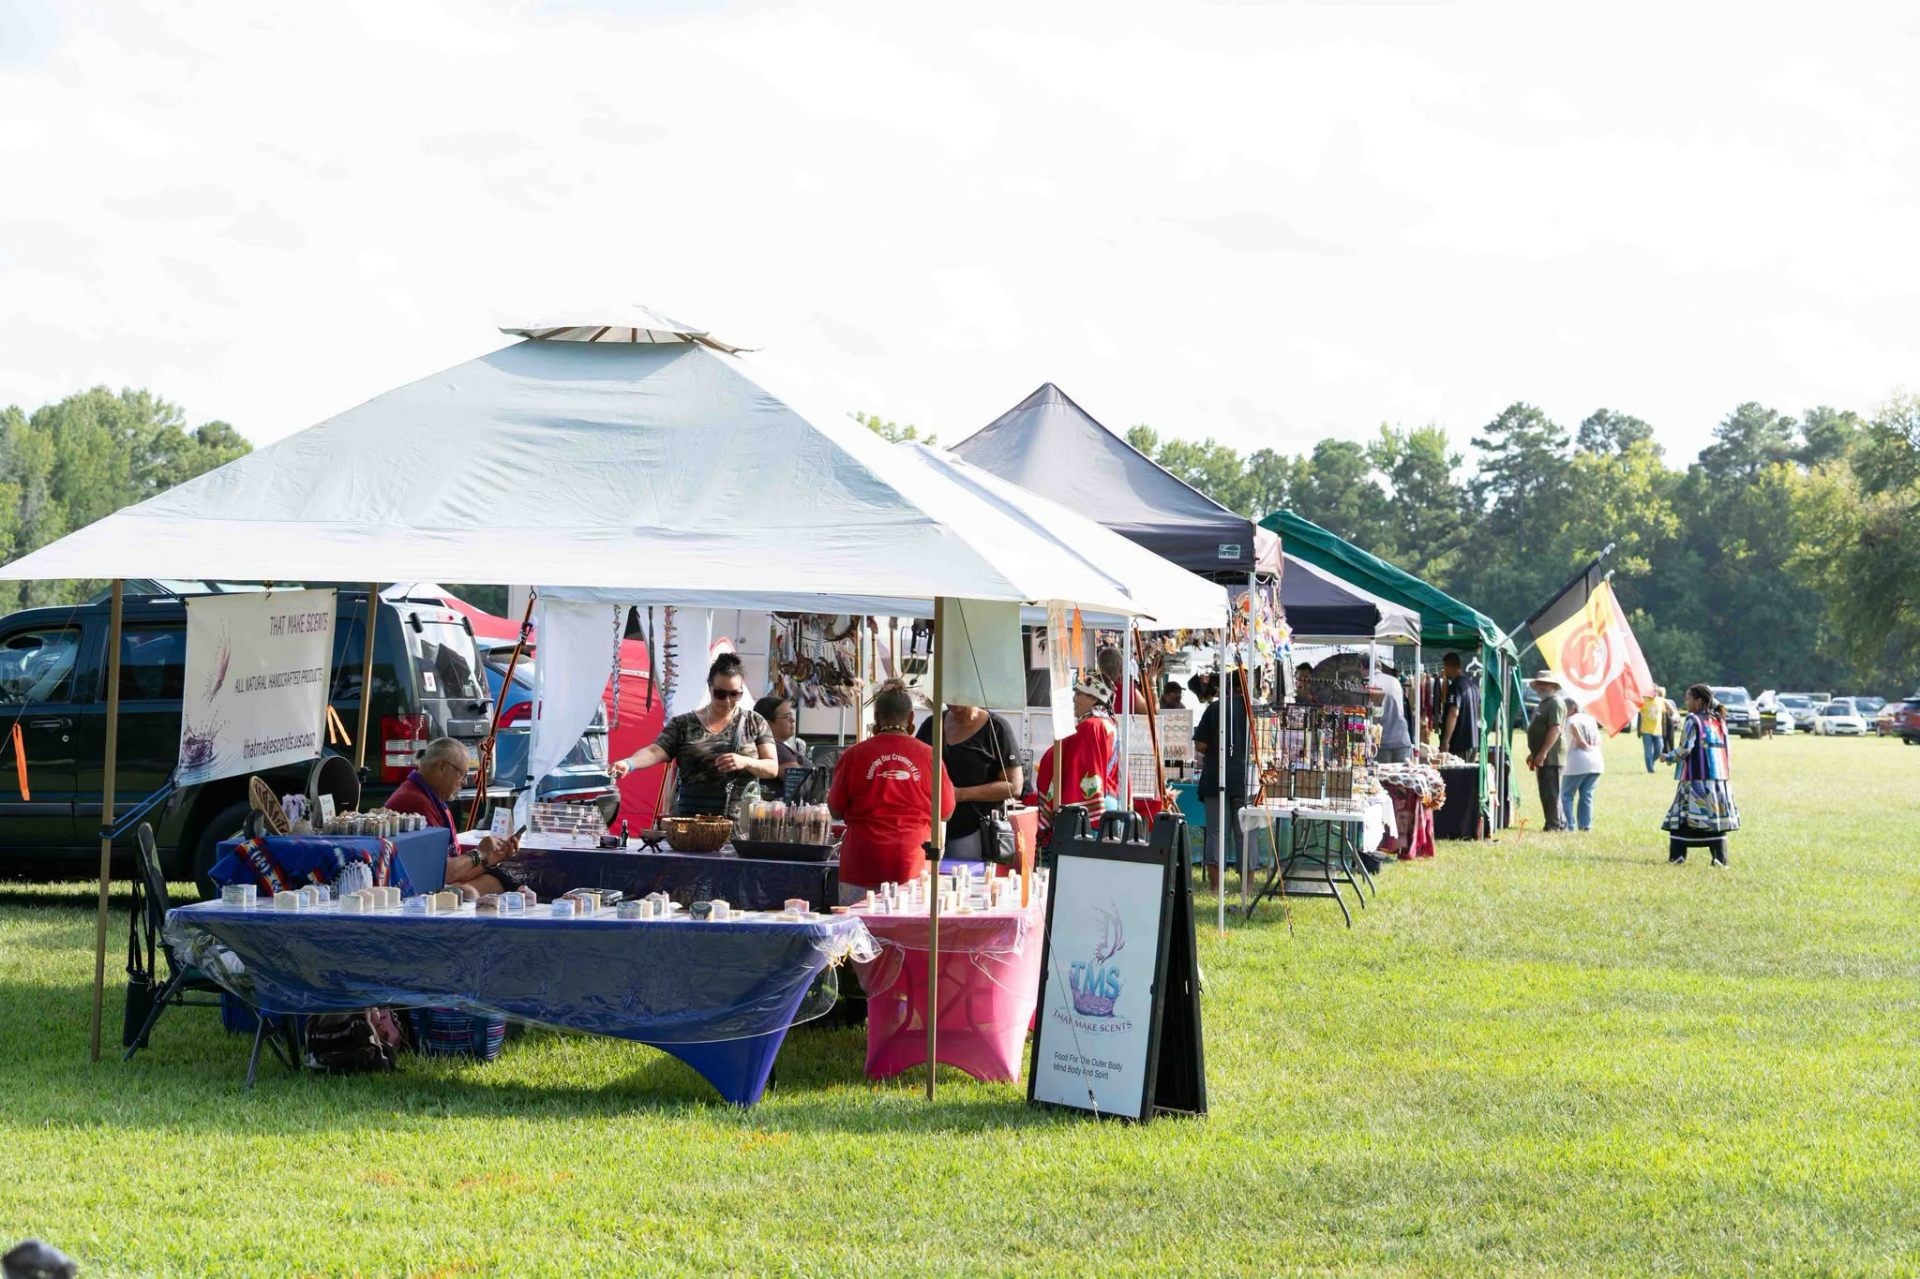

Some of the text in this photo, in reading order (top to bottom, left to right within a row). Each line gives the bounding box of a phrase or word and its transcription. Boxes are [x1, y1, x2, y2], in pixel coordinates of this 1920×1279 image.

[270, 611, 329, 637] THAT MAKE SCENTS
[234, 677, 244, 693] ALL
[245, 674, 267, 691] NATURAL
[1071, 961, 1120, 1000] TMS
[1053, 1009, 1132, 1033] THAT MAKE SCENTS
[1053, 1062, 1067, 1072] Mind
[1067, 1065, 1081, 1077] Body
[1094, 1069, 1109, 1080] Spirit
[1054, 1051, 1069, 1062] Food
[1069, 1054, 1079, 1063] For
[1091, 1058, 1107, 1068] Outer
[1107, 1060, 1123, 1072] Body
